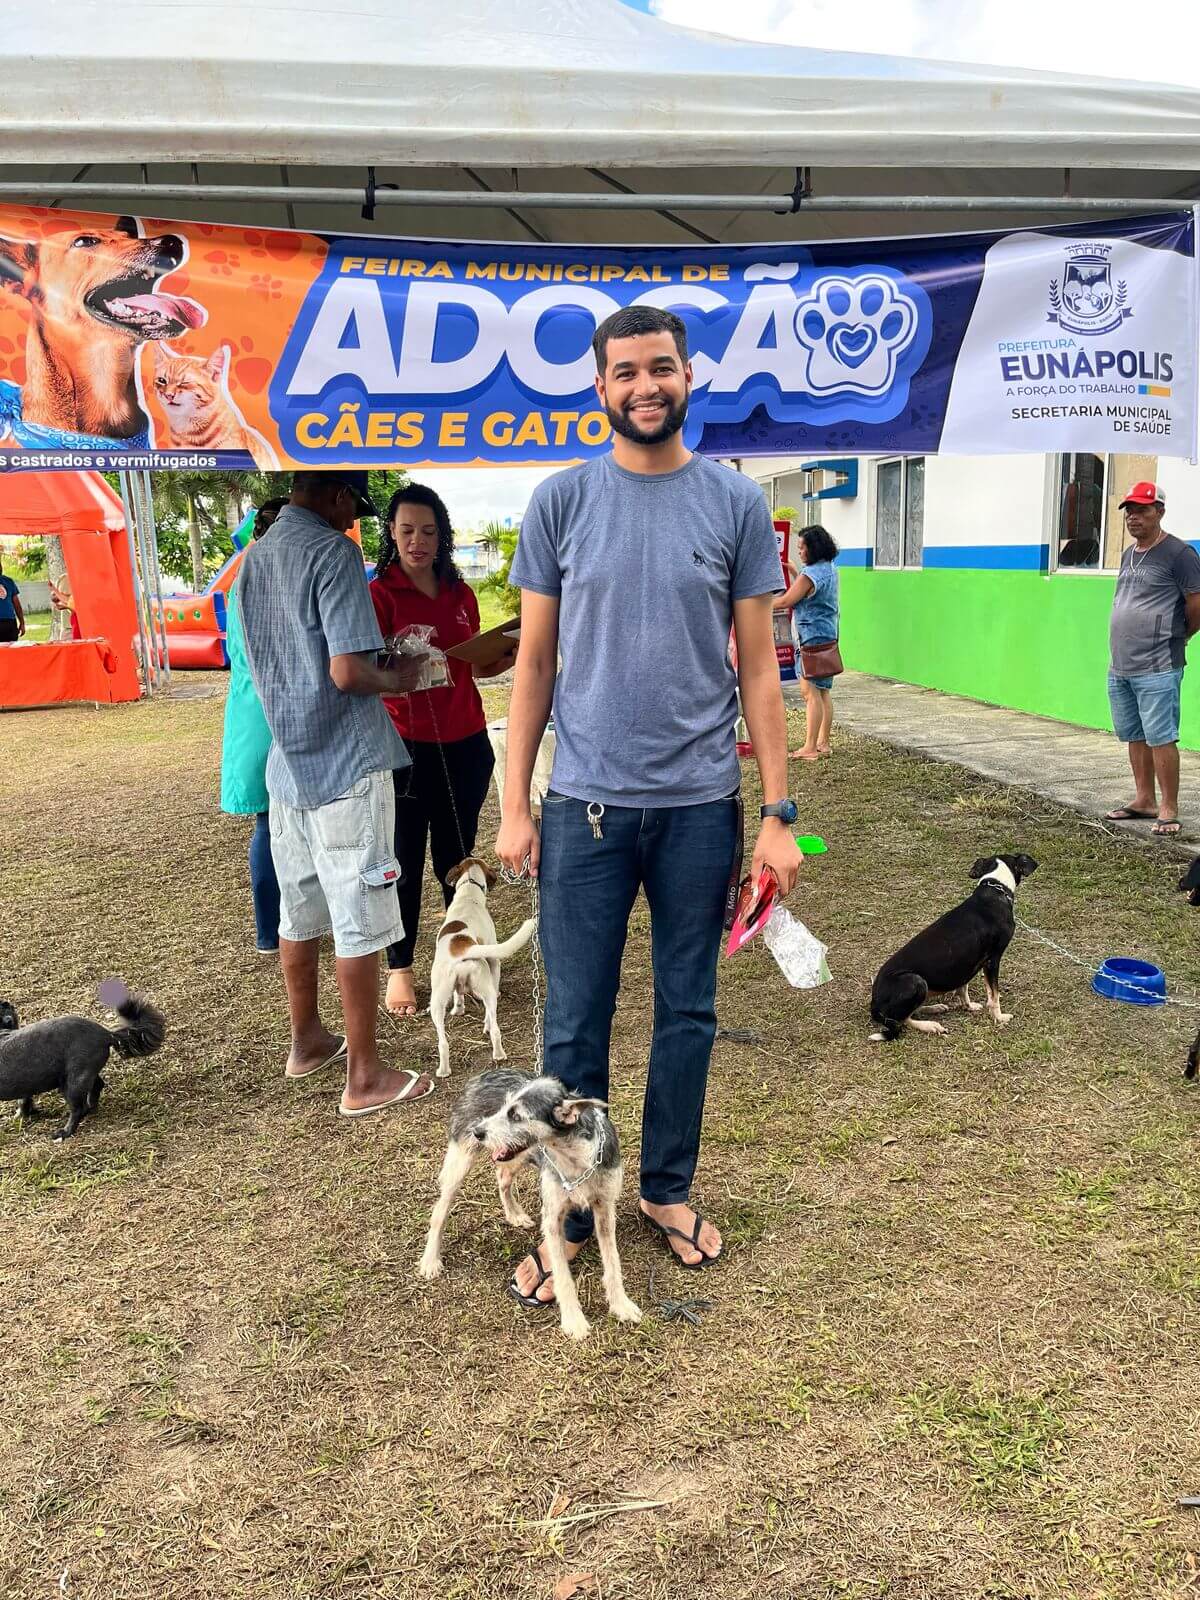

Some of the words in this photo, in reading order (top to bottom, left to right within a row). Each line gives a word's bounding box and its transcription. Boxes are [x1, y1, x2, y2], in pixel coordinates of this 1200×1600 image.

[340, 256, 454, 279] FEIRA
[464, 262, 672, 283] MUNICIPAL
[681, 264, 730, 281] DE
[998, 338, 1077, 353] PREFEITURA
[1000, 346, 1174, 382] EUNÁPOLIS
[1006, 387, 1015, 396] A
[1017, 385, 1057, 397] FORÇA
[1059, 384, 1077, 394] DO
[1079, 384, 1136, 394] TRABALHO
[1011, 405, 1103, 420] SECRETARIA
[1106, 406, 1173, 421] MUNICIPAL
[295, 402, 424, 448] CÃES
[438, 412, 469, 447] E
[481, 411, 616, 446] GATO
[1113, 420, 1131, 432] DE
[1133, 420, 1172, 435] SAÚDE
[11, 454, 93, 467] castrados
[96, 456, 105, 467] e
[109, 454, 217, 469] vermifugados
